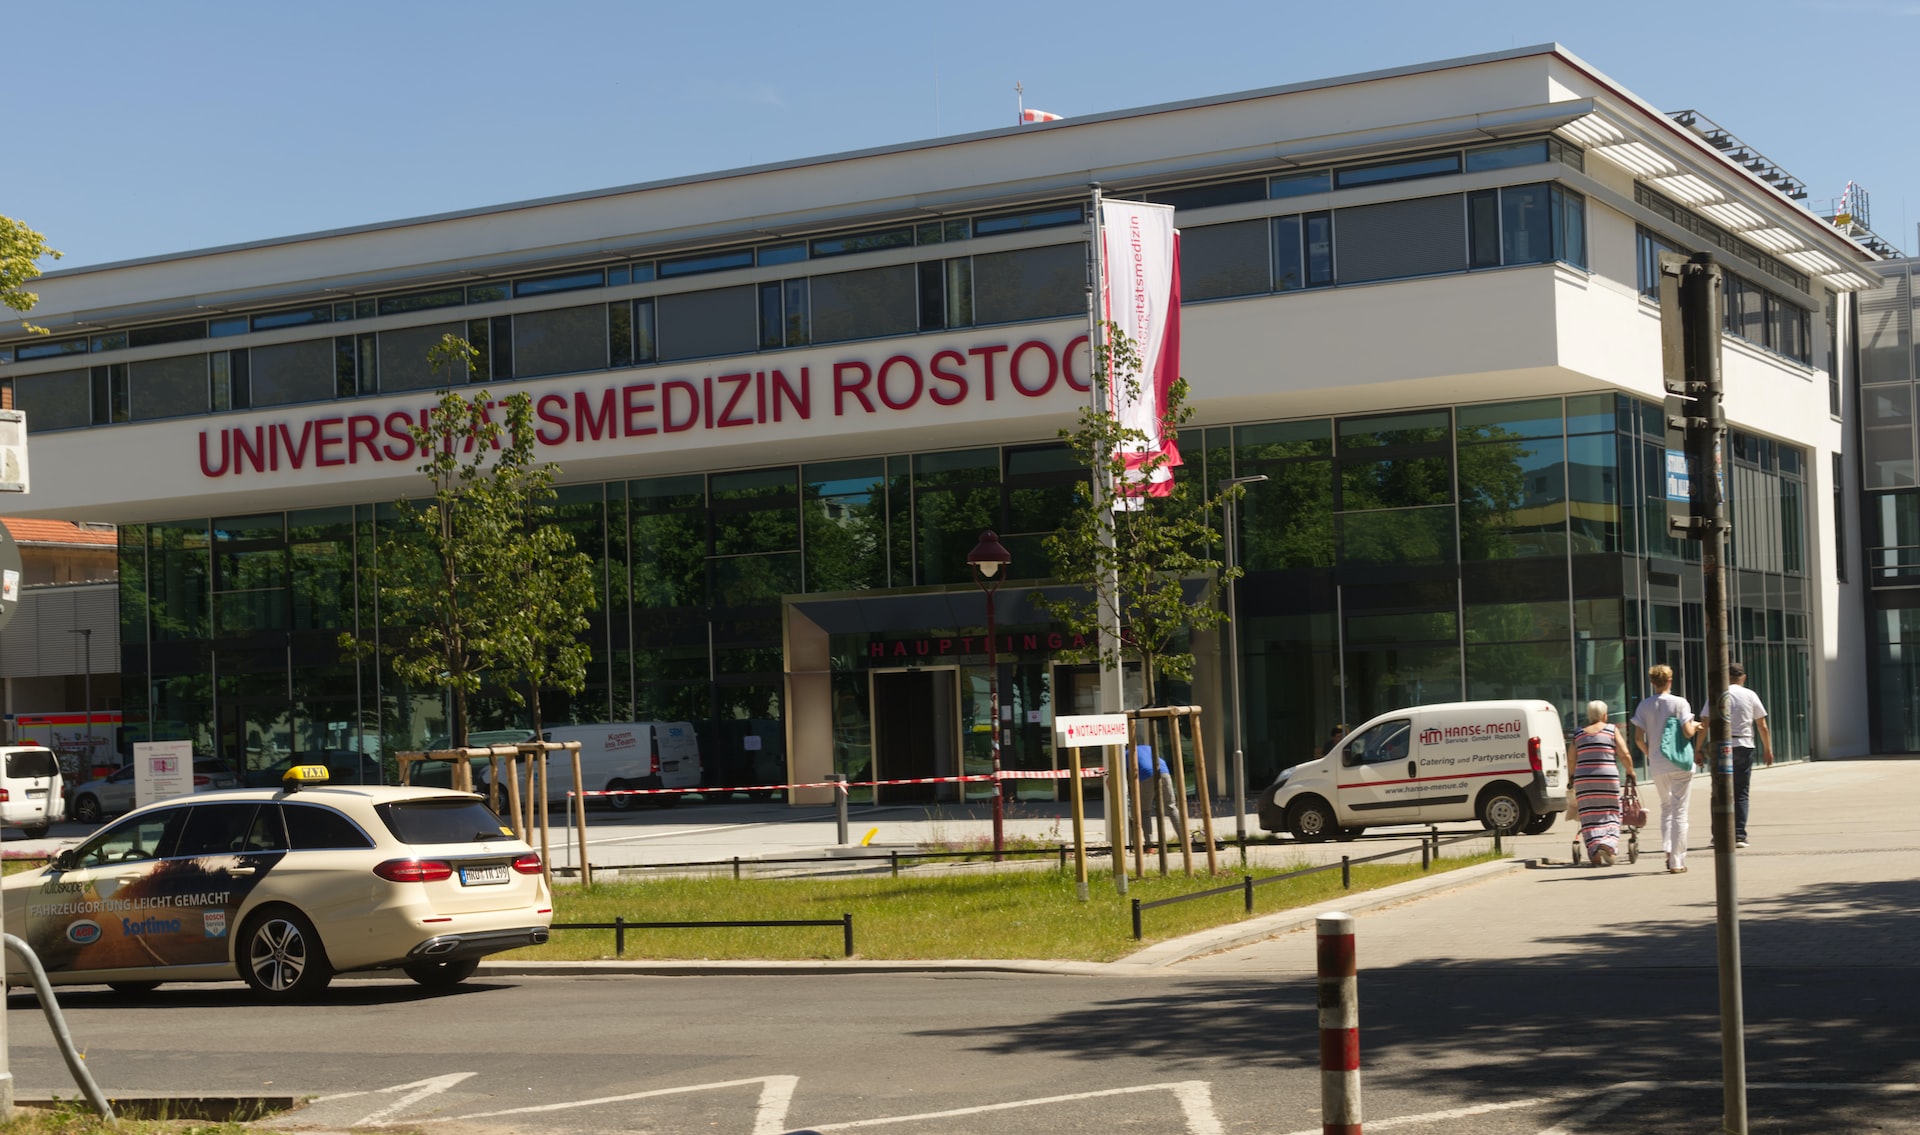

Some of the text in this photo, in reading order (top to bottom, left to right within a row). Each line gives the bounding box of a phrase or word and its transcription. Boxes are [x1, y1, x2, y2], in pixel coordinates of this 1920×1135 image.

[1129, 216, 1145, 370] iversitätsmedizin
[833, 335, 1090, 416] ROSTOC
[871, 629, 1137, 657] HAUPTINGAG
[1076, 723, 1125, 737] NOTAUFNAHME
[616, 738, 636, 746] Team
[1445, 737, 1468, 745] Service
[1495, 733, 1520, 741] Rostock
[1420, 757, 1455, 766] Catering
[1472, 752, 1526, 763] Partyservice
[302, 767, 326, 778] TAXI
[1385, 781, 1468, 795] www.hanse-menue.de
[30, 891, 230, 917] FAHRZEUGORTUNG LEICHT GEMACHT
[205, 913, 224, 921] BOSCH
[122, 915, 181, 937] Sortimo
